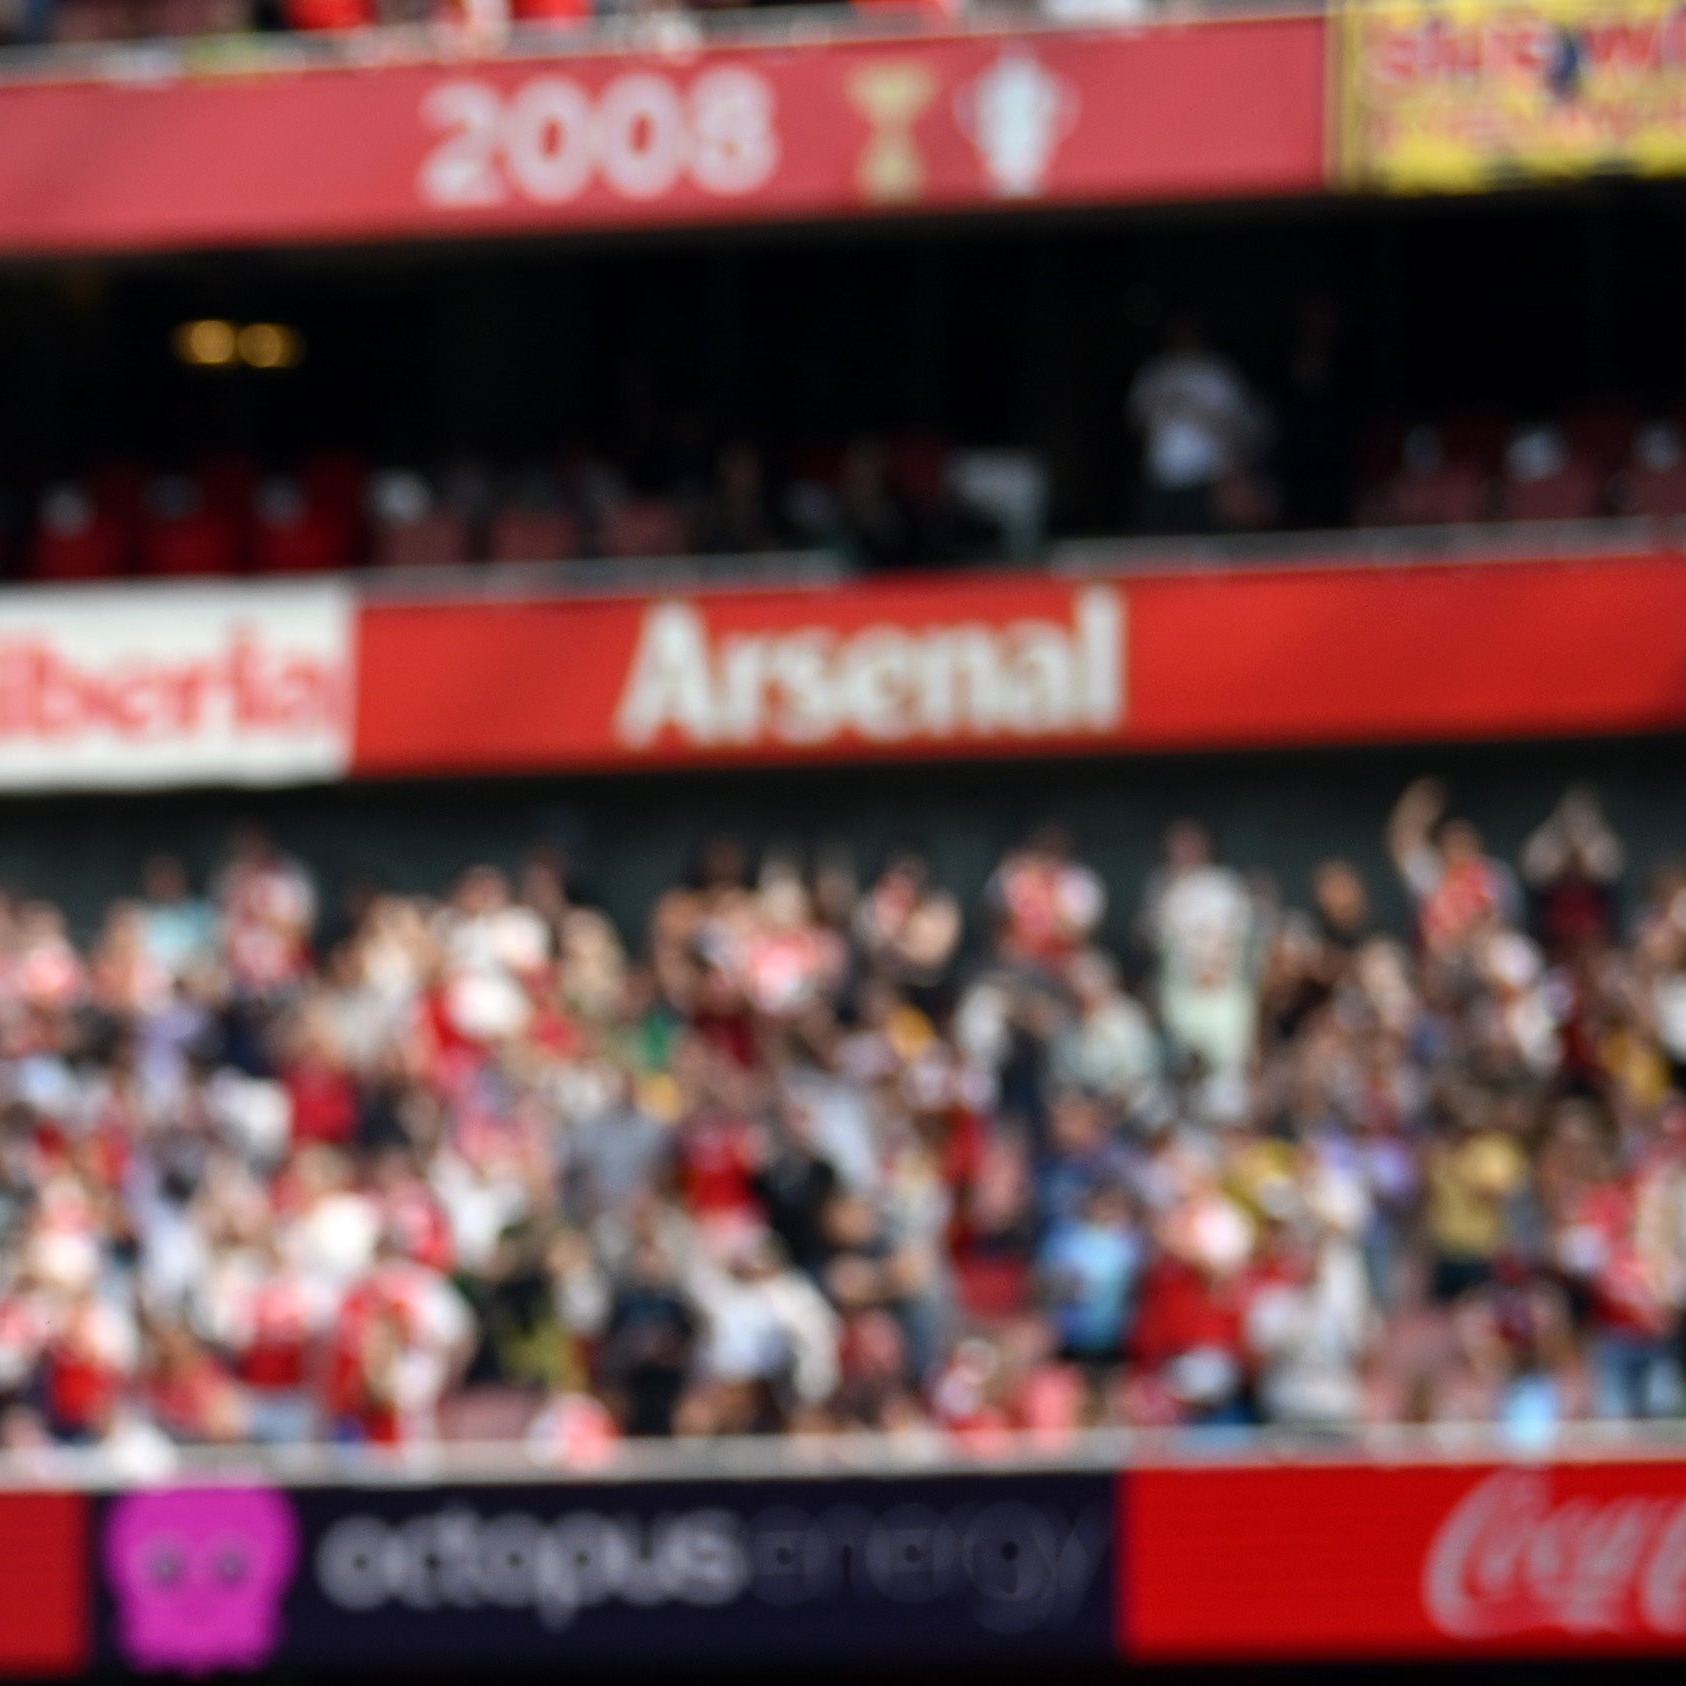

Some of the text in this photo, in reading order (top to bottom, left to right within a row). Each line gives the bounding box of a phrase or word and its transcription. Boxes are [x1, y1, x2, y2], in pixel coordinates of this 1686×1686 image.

[418, 62, 780, 205] 2008
[617, 586, 1126, 748] Arsenal
[314, 1504, 748, 1634] octopus
